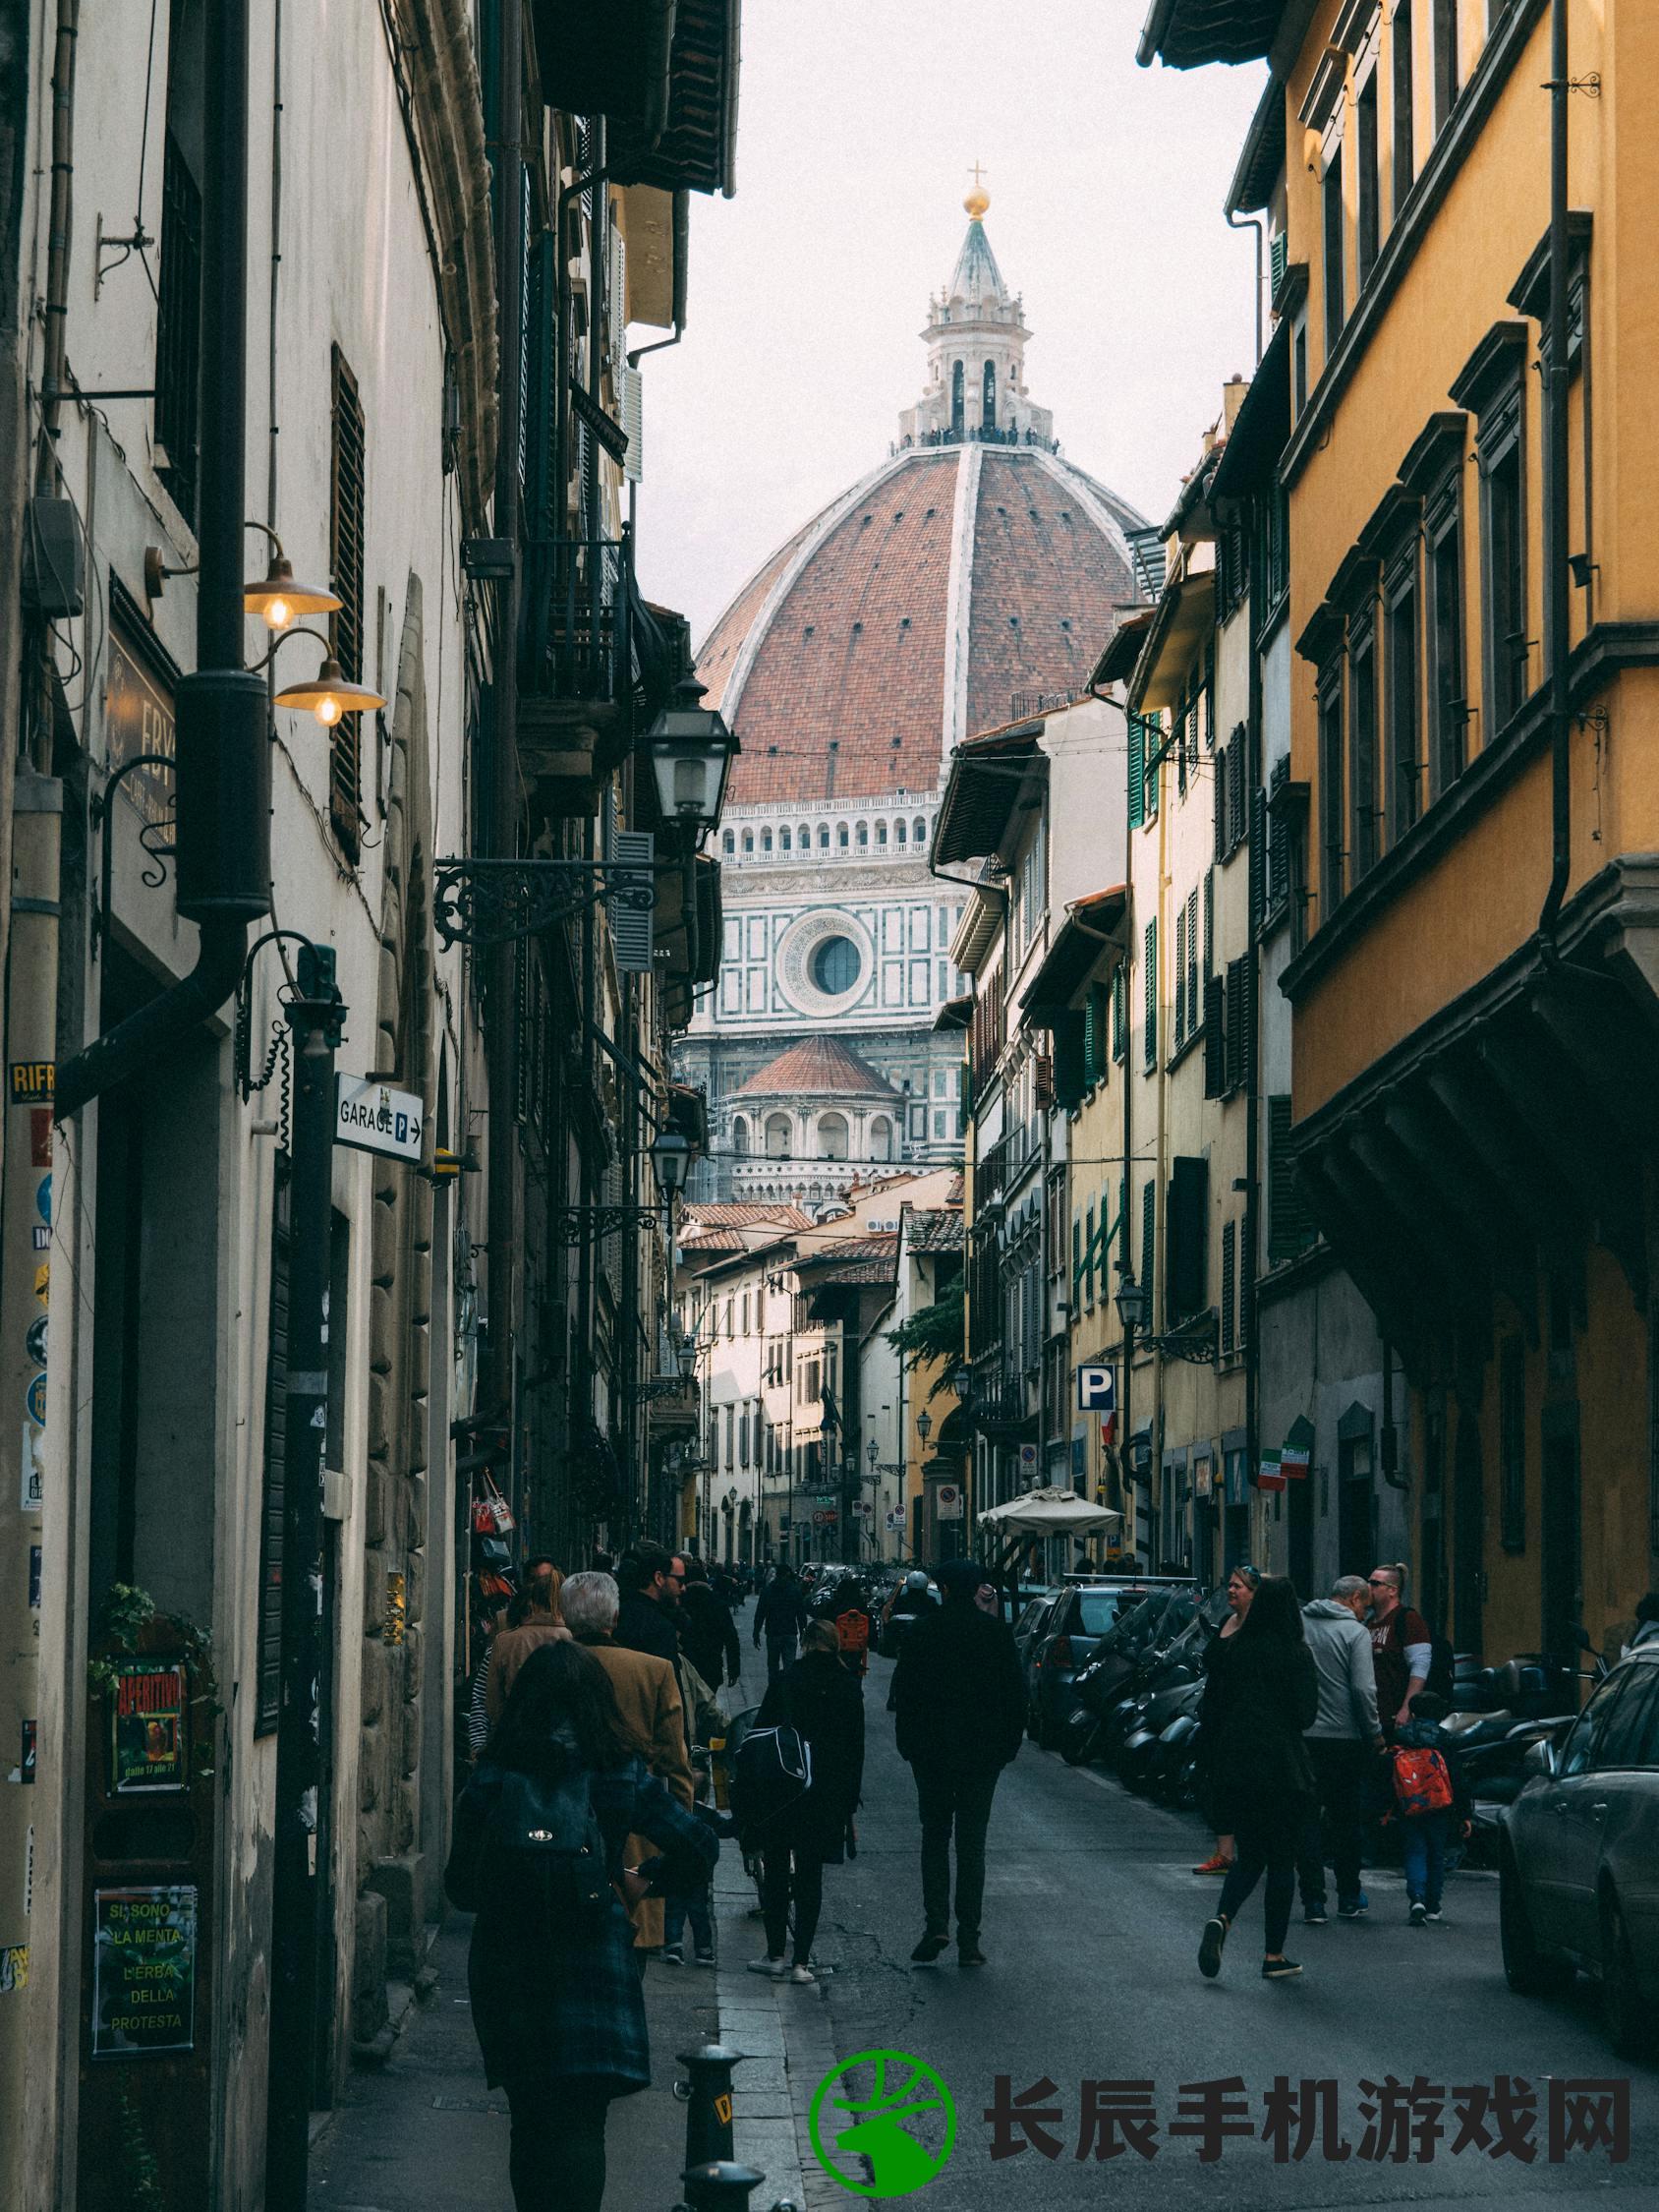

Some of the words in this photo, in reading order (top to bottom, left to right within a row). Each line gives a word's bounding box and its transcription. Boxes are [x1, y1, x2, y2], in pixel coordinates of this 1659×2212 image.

[340, 1100, 393, 1135] GARAGE
[1082, 1368, 1113, 1408] P
[131, 1903, 170, 1917] SONO
[114, 1930, 132, 1944] LA
[124, 1965, 173, 1980] L'ERBA
[131, 1989, 174, 2004] DELLA
[111, 2013, 182, 2030] PROTESTA
